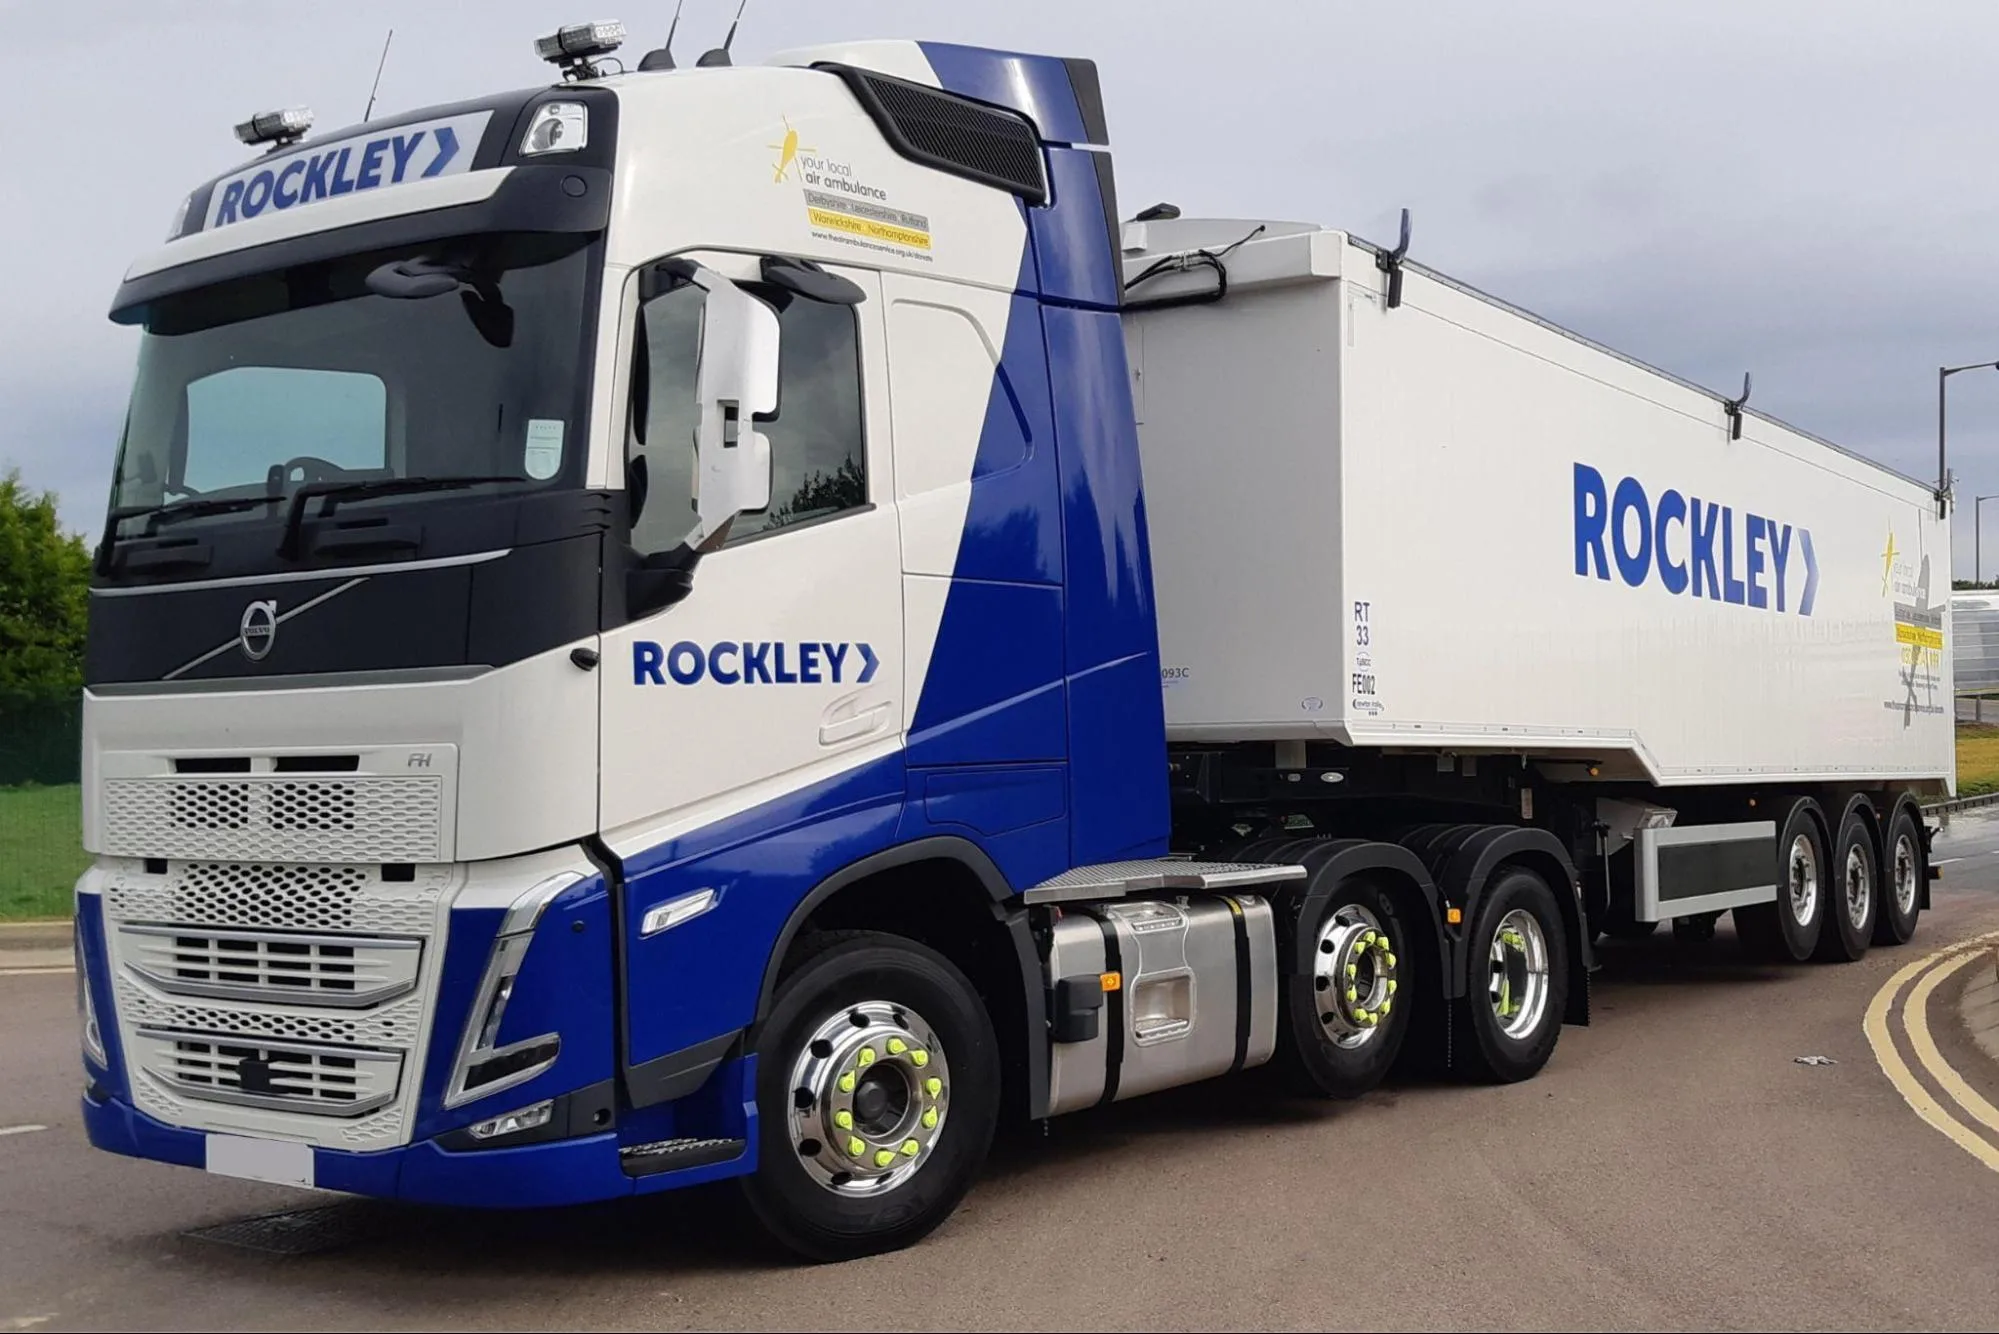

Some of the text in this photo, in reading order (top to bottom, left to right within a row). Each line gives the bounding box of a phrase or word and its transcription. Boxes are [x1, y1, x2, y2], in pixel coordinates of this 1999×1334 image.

[800, 156, 852, 177] your local
[215, 131, 426, 228] ROCKLEY
[806, 171, 886, 200] air ambulance
[813, 211, 861, 231] Warwickshire
[1573, 461, 1792, 613] ROCKLEY
[1354, 601, 1370, 622] RT
[1356, 625, 1369, 646] 33
[632, 641, 849, 686] ROCKLEY
